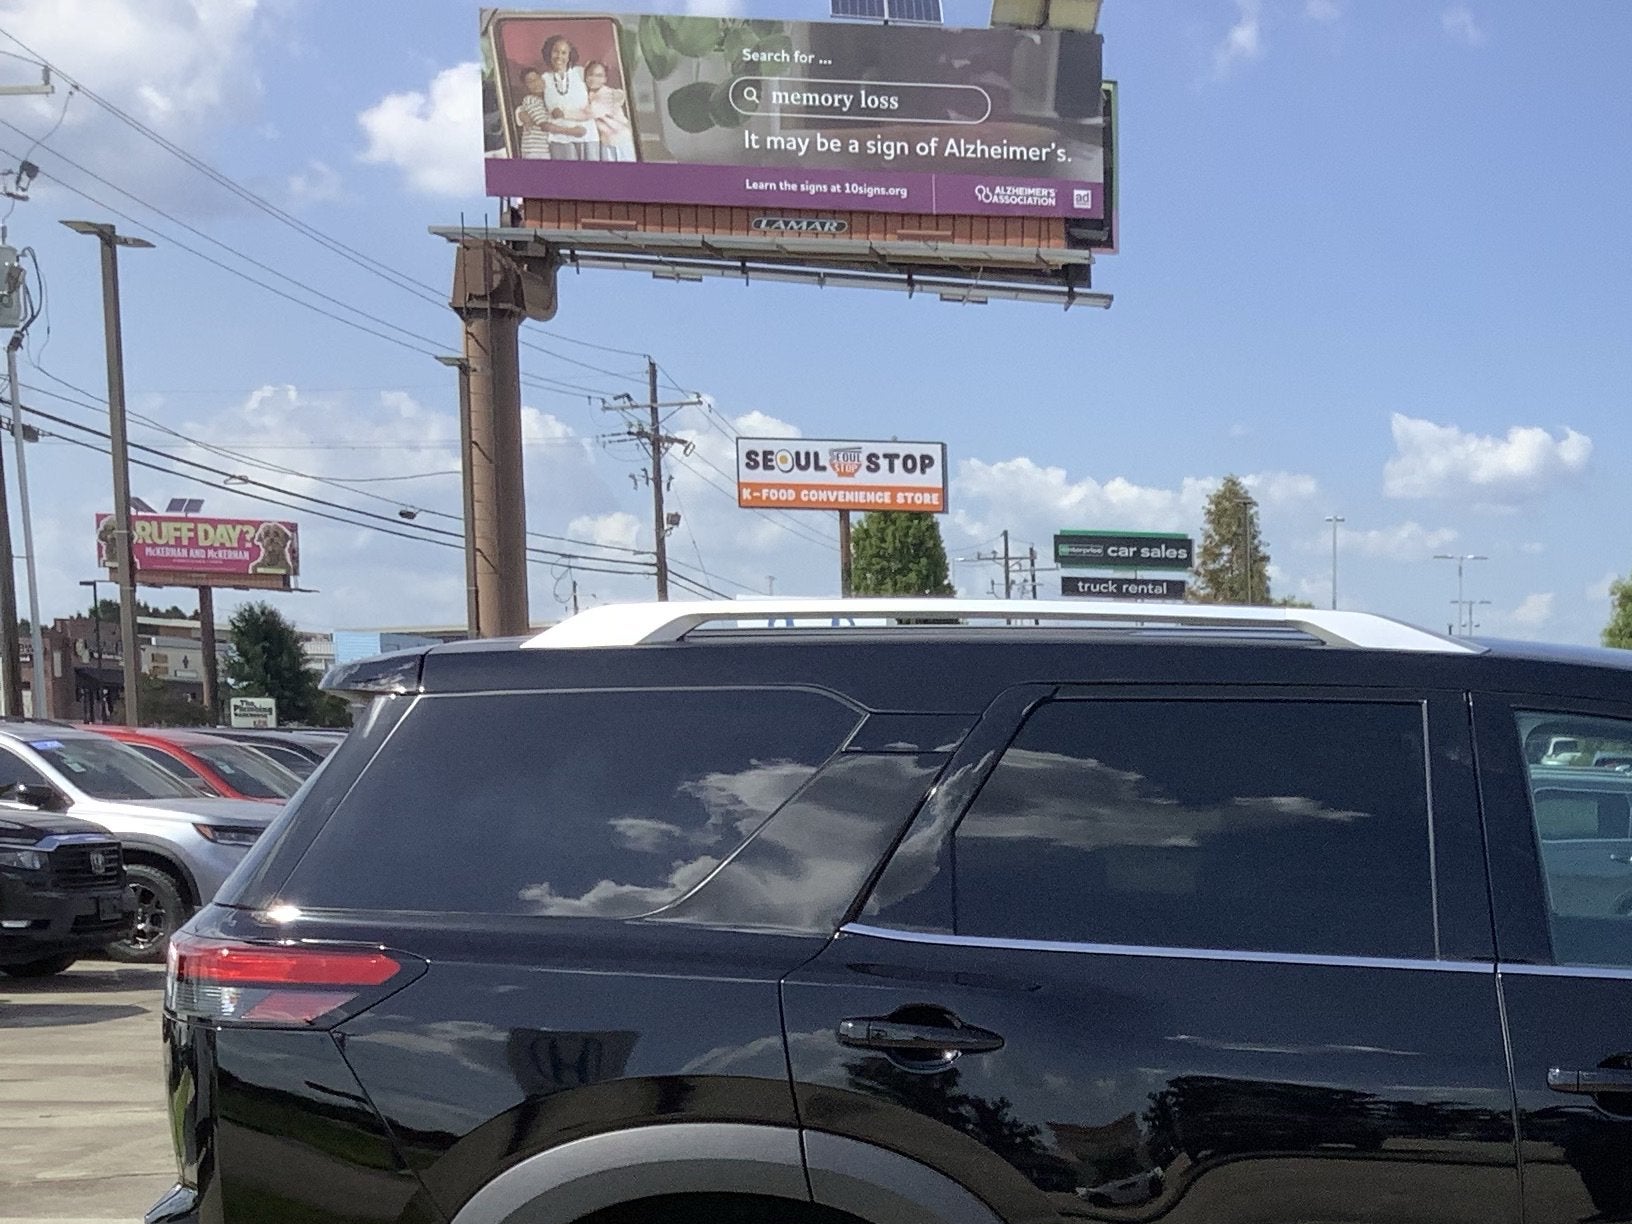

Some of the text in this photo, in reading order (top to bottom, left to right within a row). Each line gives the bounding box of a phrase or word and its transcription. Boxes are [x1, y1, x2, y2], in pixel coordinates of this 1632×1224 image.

[742, 48, 790, 63] Search
[793, 50, 815, 64] for
[771, 90, 899, 112] memory loss
[744, 130, 1073, 164] It may be a sign of Alzheimer's.
[745, 178, 908, 199] Learn the signs at 10signs.org
[994, 185, 1056, 197] ALZHEIMER'S
[992, 194, 1056, 207] ASSOCIATION
[758, 219, 839, 233] LAMAR
[745, 448, 935, 474] SEOUL STOP
[743, 488, 940, 505] K-FOOD CONVENIENCE STORE
[135, 520, 256, 548] RUFF DAY?
[190, 548, 206, 559] AND
[1107, 545, 1137, 558] car
[1140, 544, 1188, 559] sales
[1077, 580, 1168, 595] truck rental
